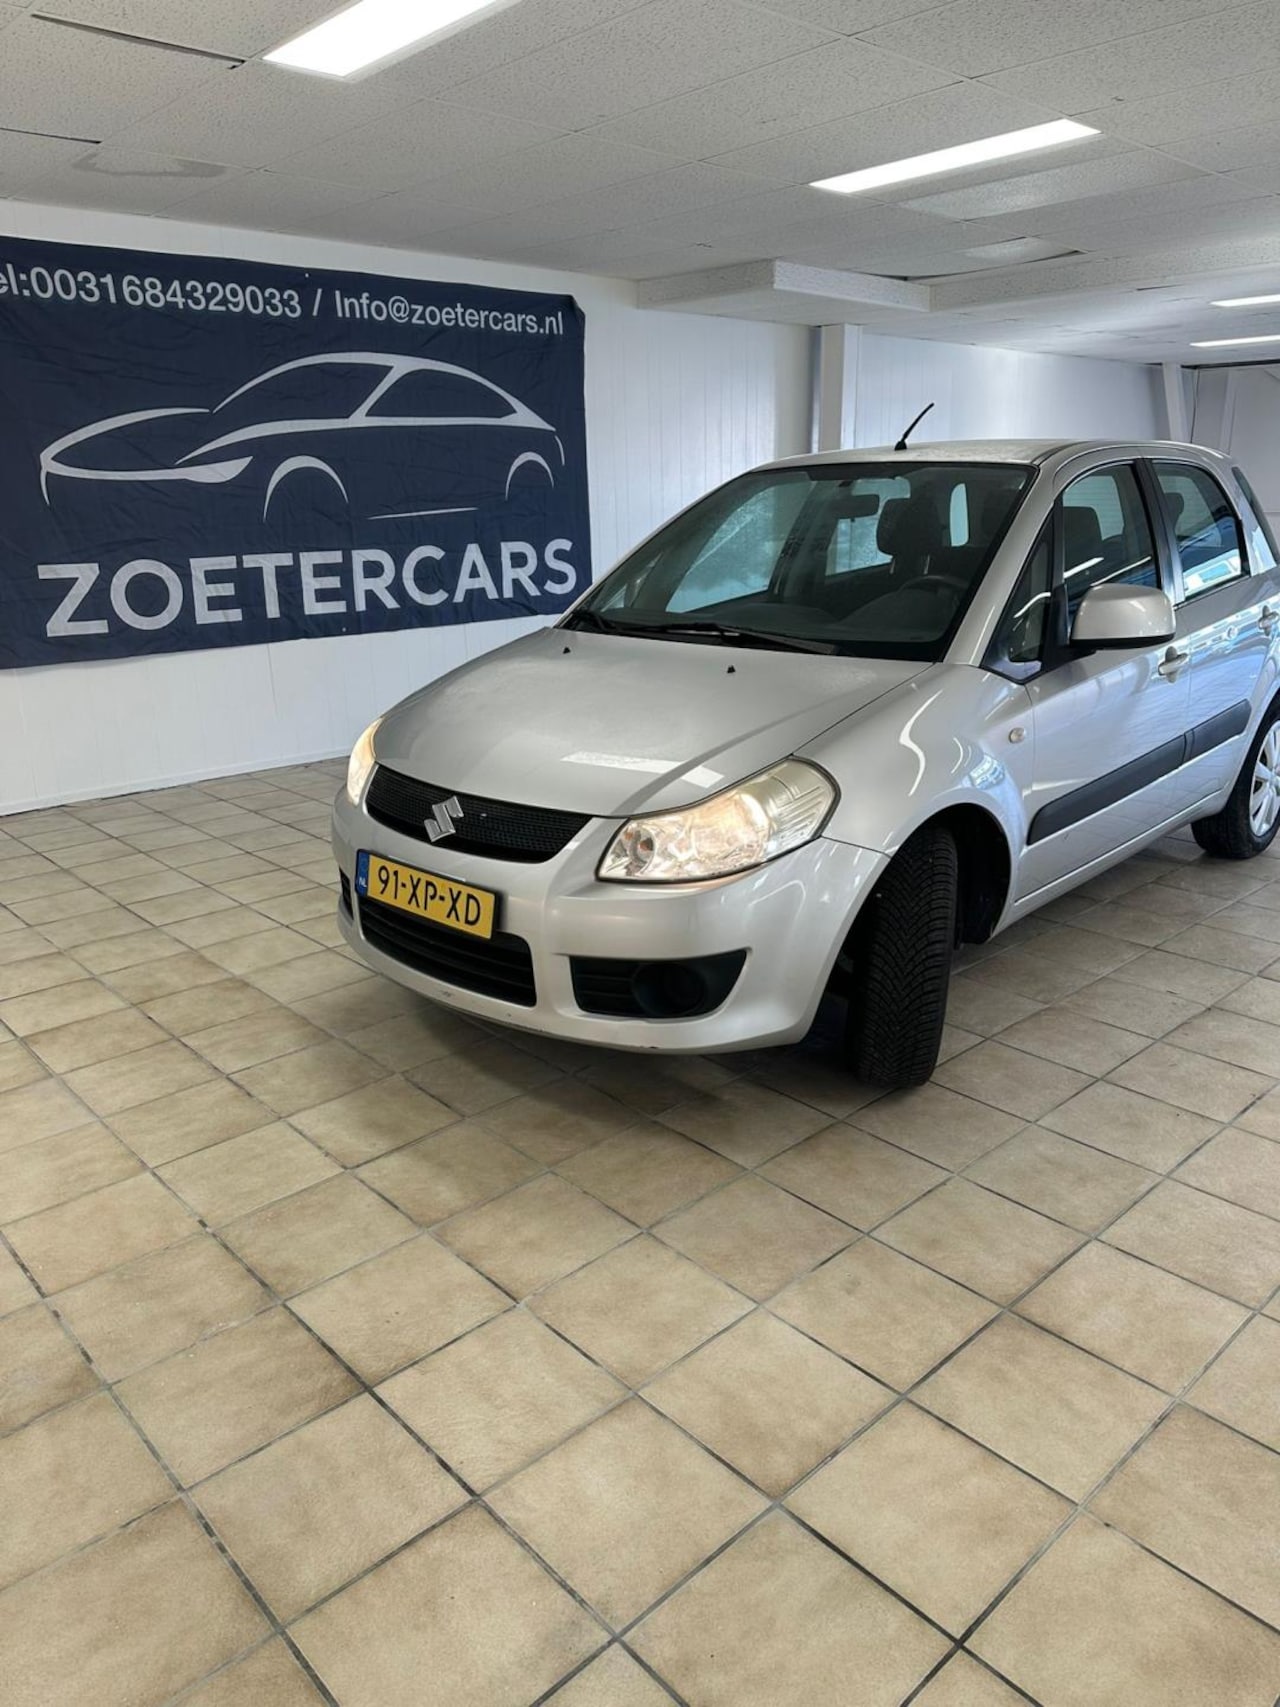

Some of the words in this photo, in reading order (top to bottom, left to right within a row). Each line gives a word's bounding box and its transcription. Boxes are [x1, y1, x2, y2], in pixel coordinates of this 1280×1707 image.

[335, 290, 564, 335] Info@zoetercars.nl
[37, 538, 577, 638] ZOETERCARS
[378, 866, 481, 926] 91-XP-XD
